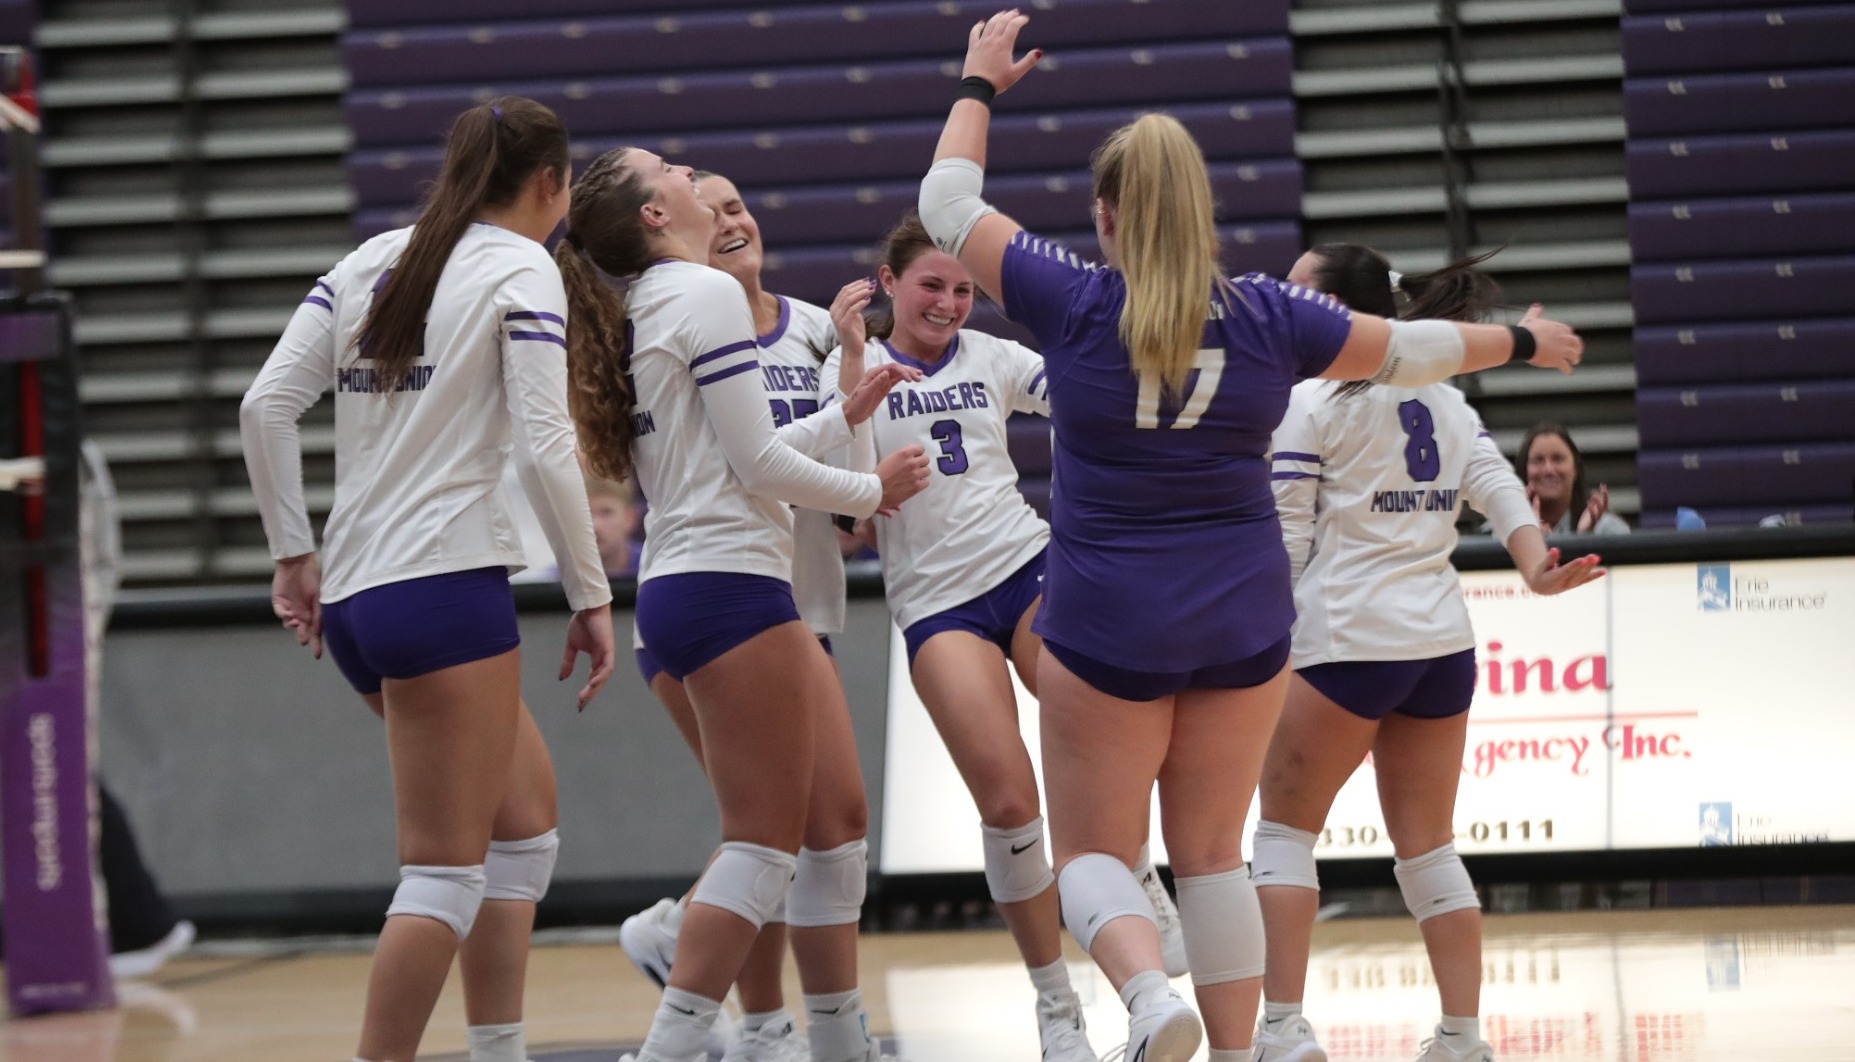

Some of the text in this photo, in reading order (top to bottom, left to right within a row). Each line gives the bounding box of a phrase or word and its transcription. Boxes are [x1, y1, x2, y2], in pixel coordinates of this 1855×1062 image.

[337, 366, 393, 393] MOUN
[762, 365, 819, 391] IDERS
[888, 382, 989, 420] RAIDERS
[930, 419, 969, 476] 3
[1397, 398, 1440, 482] 8
[1462, 724, 1691, 778] gency Inc.
